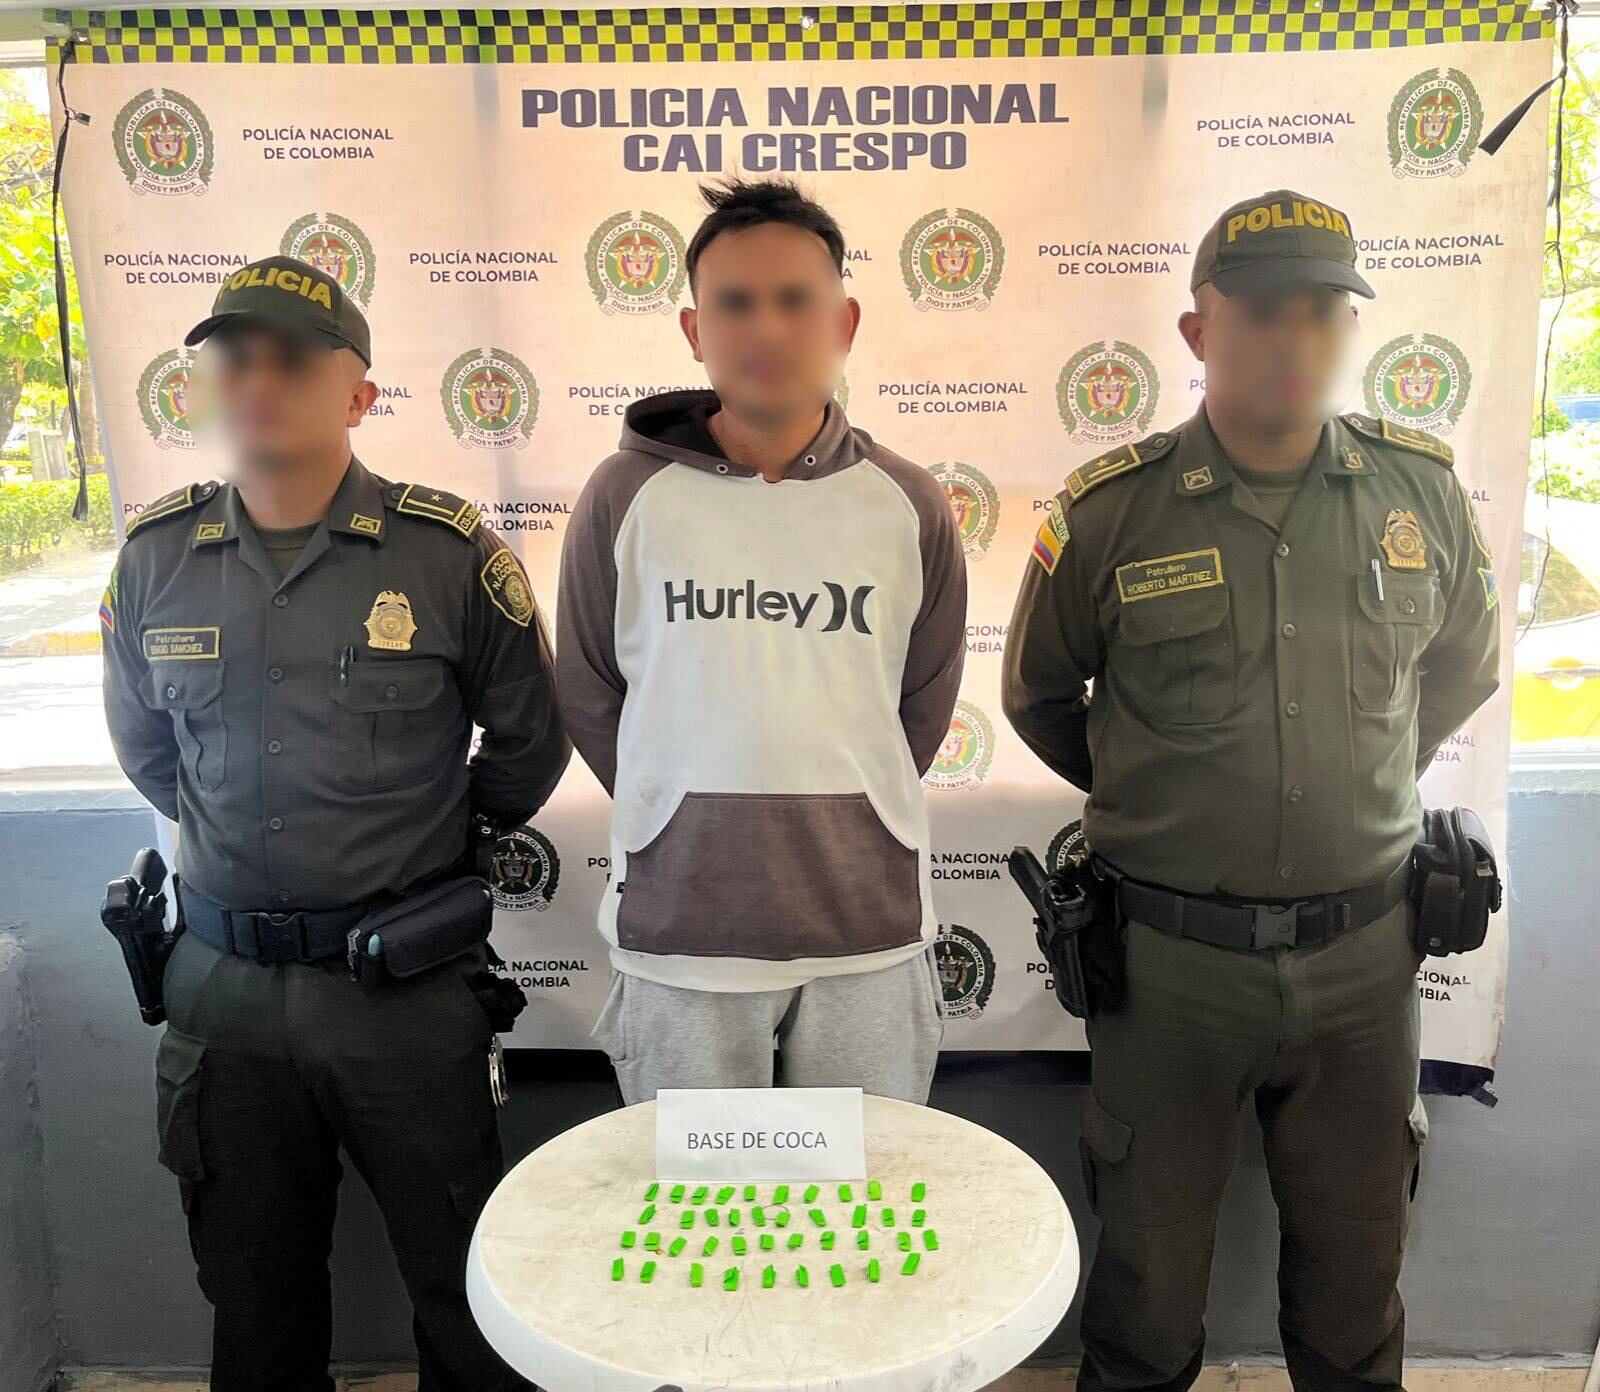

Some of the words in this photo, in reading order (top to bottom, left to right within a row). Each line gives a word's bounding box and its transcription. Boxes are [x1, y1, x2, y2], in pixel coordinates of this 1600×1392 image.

[522, 88, 748, 127] POLICIA
[768, 83, 1069, 126] NACIONAL
[1197, 115, 1263, 131] POLICÍA
[1268, 113, 1355, 127] NACIONAL
[242, 126, 306, 140] POLICÍA
[310, 128, 394, 140] NACIONAL
[1218, 136, 1240, 147] DE
[1244, 132, 1334, 146] COLOMBIA
[263, 147, 285, 159] DE
[289, 147, 375, 159] COLOMBIA
[623, 134, 722, 172] CAI
[742, 131, 967, 172] CRESPO
[1227, 201, 1350, 243] POLICIA
[1038, 241, 1103, 257] POLICÍA
[1107, 243, 1191, 256] NACIONAL
[1415, 234, 1504, 250] NACIONAL
[104, 251, 163, 266] POLICÍA
[168, 254, 249, 266] NACIONAL
[409, 250, 472, 264] POLICÍA
[476, 252, 558, 264] NACIONAL
[1365, 257, 1386, 269] DE
[1391, 253, 1482, 268] COLOMBIA
[1058, 263, 1080, 275] DE
[1084, 261, 1171, 274] COLOMBIA
[126, 272, 146, 284] DE
[430, 271, 451, 282] DE
[455, 270, 539, 282] COLOMBIA
[568, 384, 630, 398] POLICÍA
[878, 381, 941, 395] POLICÍA
[945, 382, 1028, 395] NACIONAL
[589, 404, 610, 415] DE
[898, 402, 919, 413] DE
[923, 401, 1008, 413] COLOMBIA
[493, 502, 571, 514] NACIONAL
[483, 520, 554, 531] OLOMBIA
[1146, 564, 1186, 577] Patrullero
[1127, 579, 1165, 595] ROBERTO
[1169, 570, 1212, 587] MARTINEZ
[664, 579, 820, 628] Hurley
[942, 853, 1008, 864] NACIONA
[931, 869, 1001, 880] OLOMBIA
[512, 960, 588, 972] NACIONAL
[688, 1132, 735, 1149] BASE
[742, 1132, 766, 1149] DE
[773, 1131, 827, 1149] COCA
